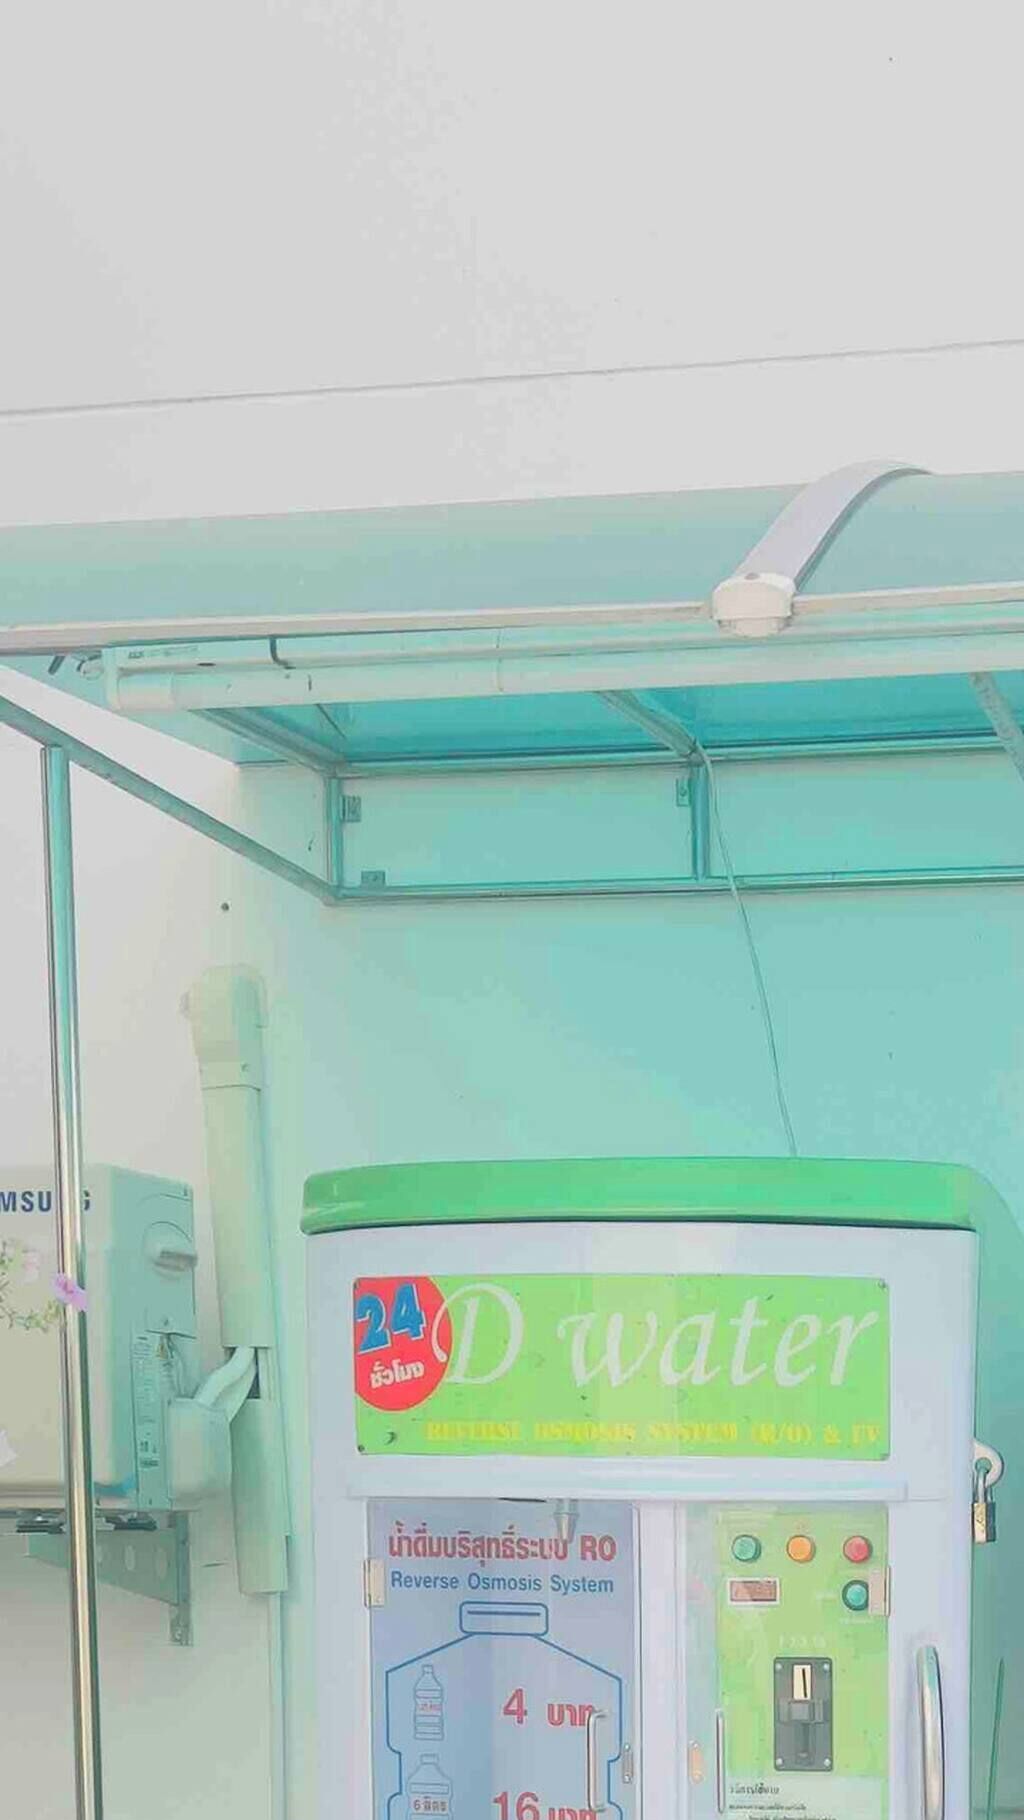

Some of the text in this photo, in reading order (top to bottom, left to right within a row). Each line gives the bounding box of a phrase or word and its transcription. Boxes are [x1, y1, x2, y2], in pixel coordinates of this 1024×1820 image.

[354, 1281, 427, 1355] 24
[431, 1282, 879, 1388] D water
[370, 1358, 424, 1389] ชั่วโมง
[580, 1534, 617, 1561] RO
[391, 1571, 614, 1595] Reverse Osmosis System
[503, 1688, 593, 1727] 4 บาท
